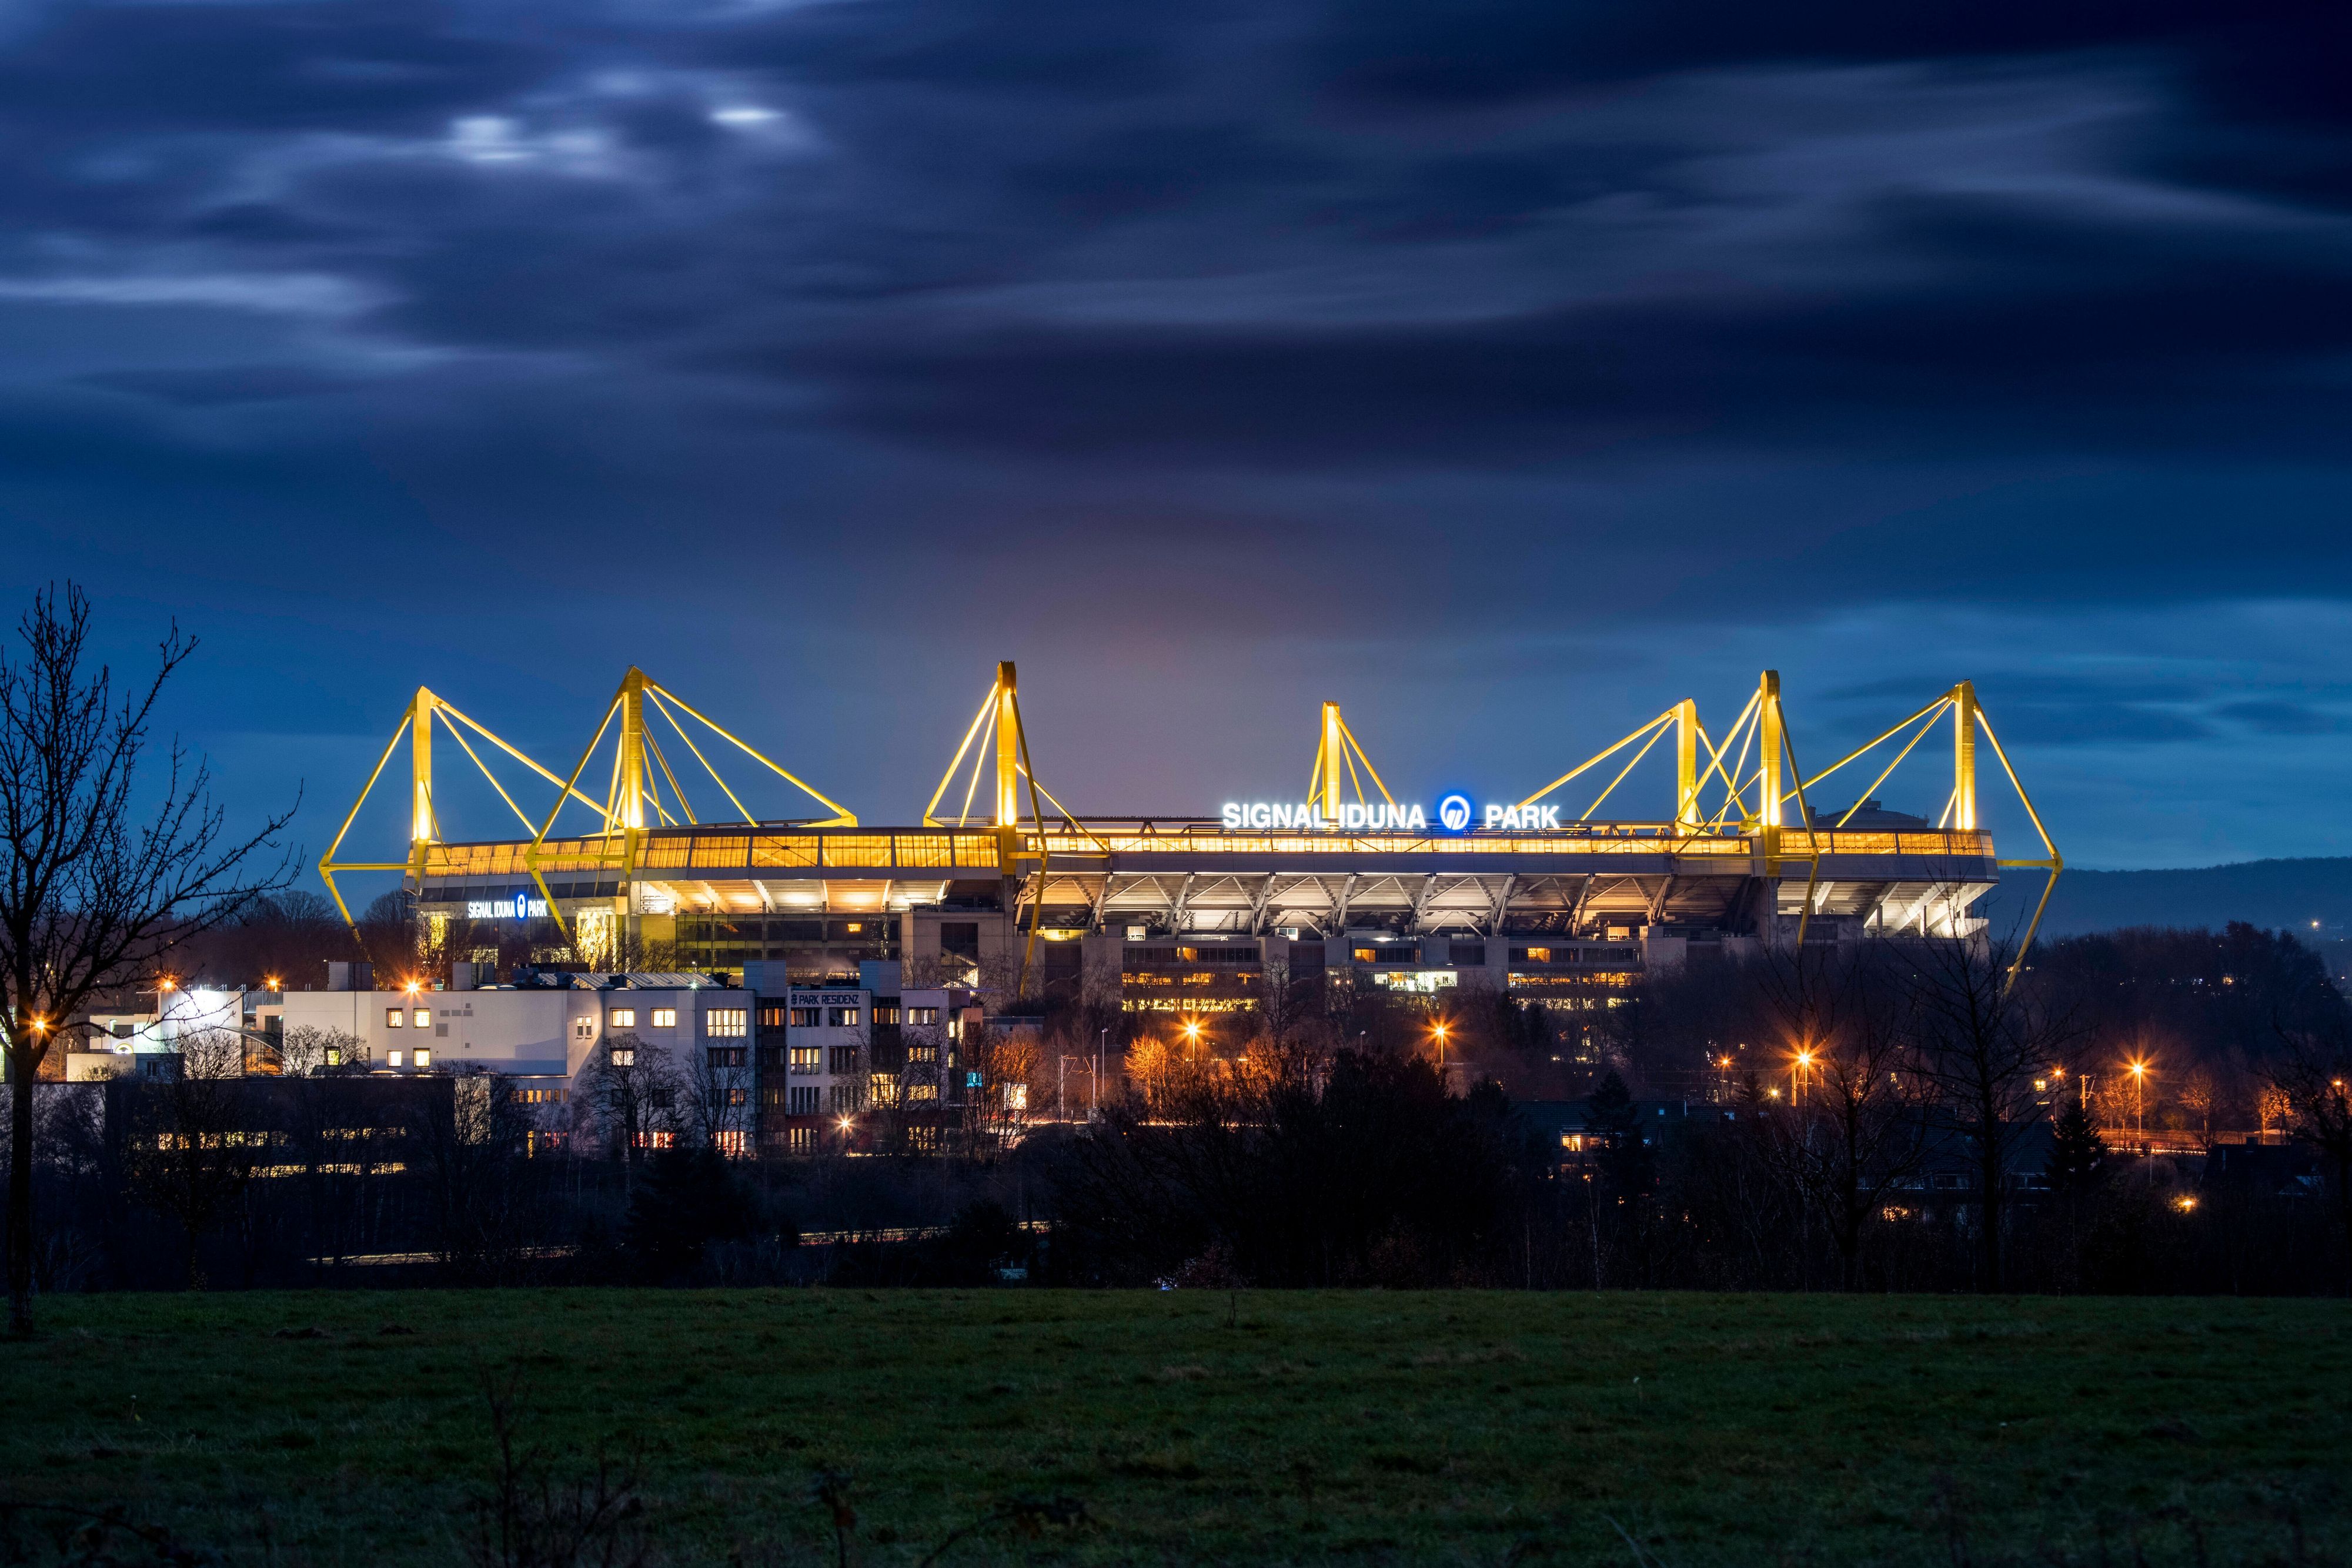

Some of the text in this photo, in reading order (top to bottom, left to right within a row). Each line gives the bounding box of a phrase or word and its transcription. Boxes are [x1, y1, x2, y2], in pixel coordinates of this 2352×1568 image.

[1222, 803, 1560, 829] SIGNAL IDUNA PARK
[468, 900, 547, 918] SIGNAL IDUNA PARK
[799, 994, 859, 1005] PARK RESIDENZ
